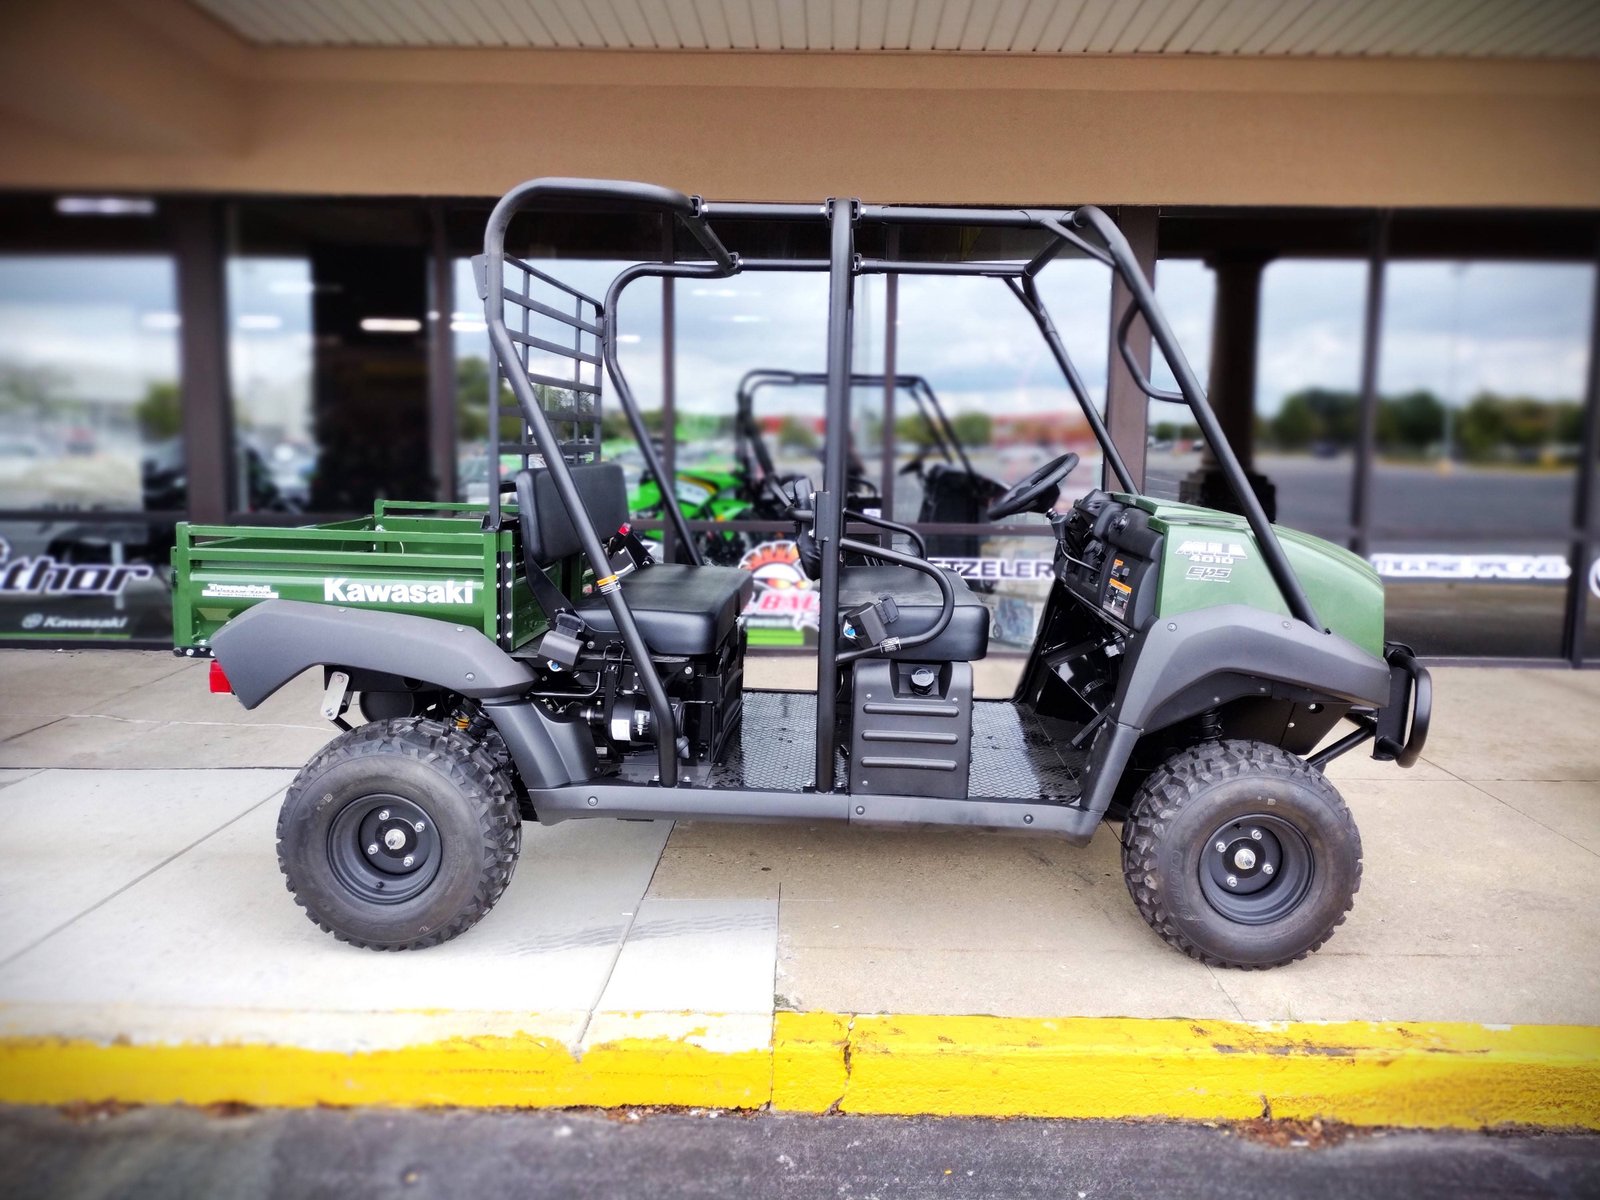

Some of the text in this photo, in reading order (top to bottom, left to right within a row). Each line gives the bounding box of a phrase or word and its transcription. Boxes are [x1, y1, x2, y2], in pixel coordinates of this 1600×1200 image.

[927, 559, 1054, 577] TZELER
[1190, 556, 1233, 565] 4010
[324, 577, 474, 604] Kawasaki
[43, 615, 129, 629] Kawasaki
